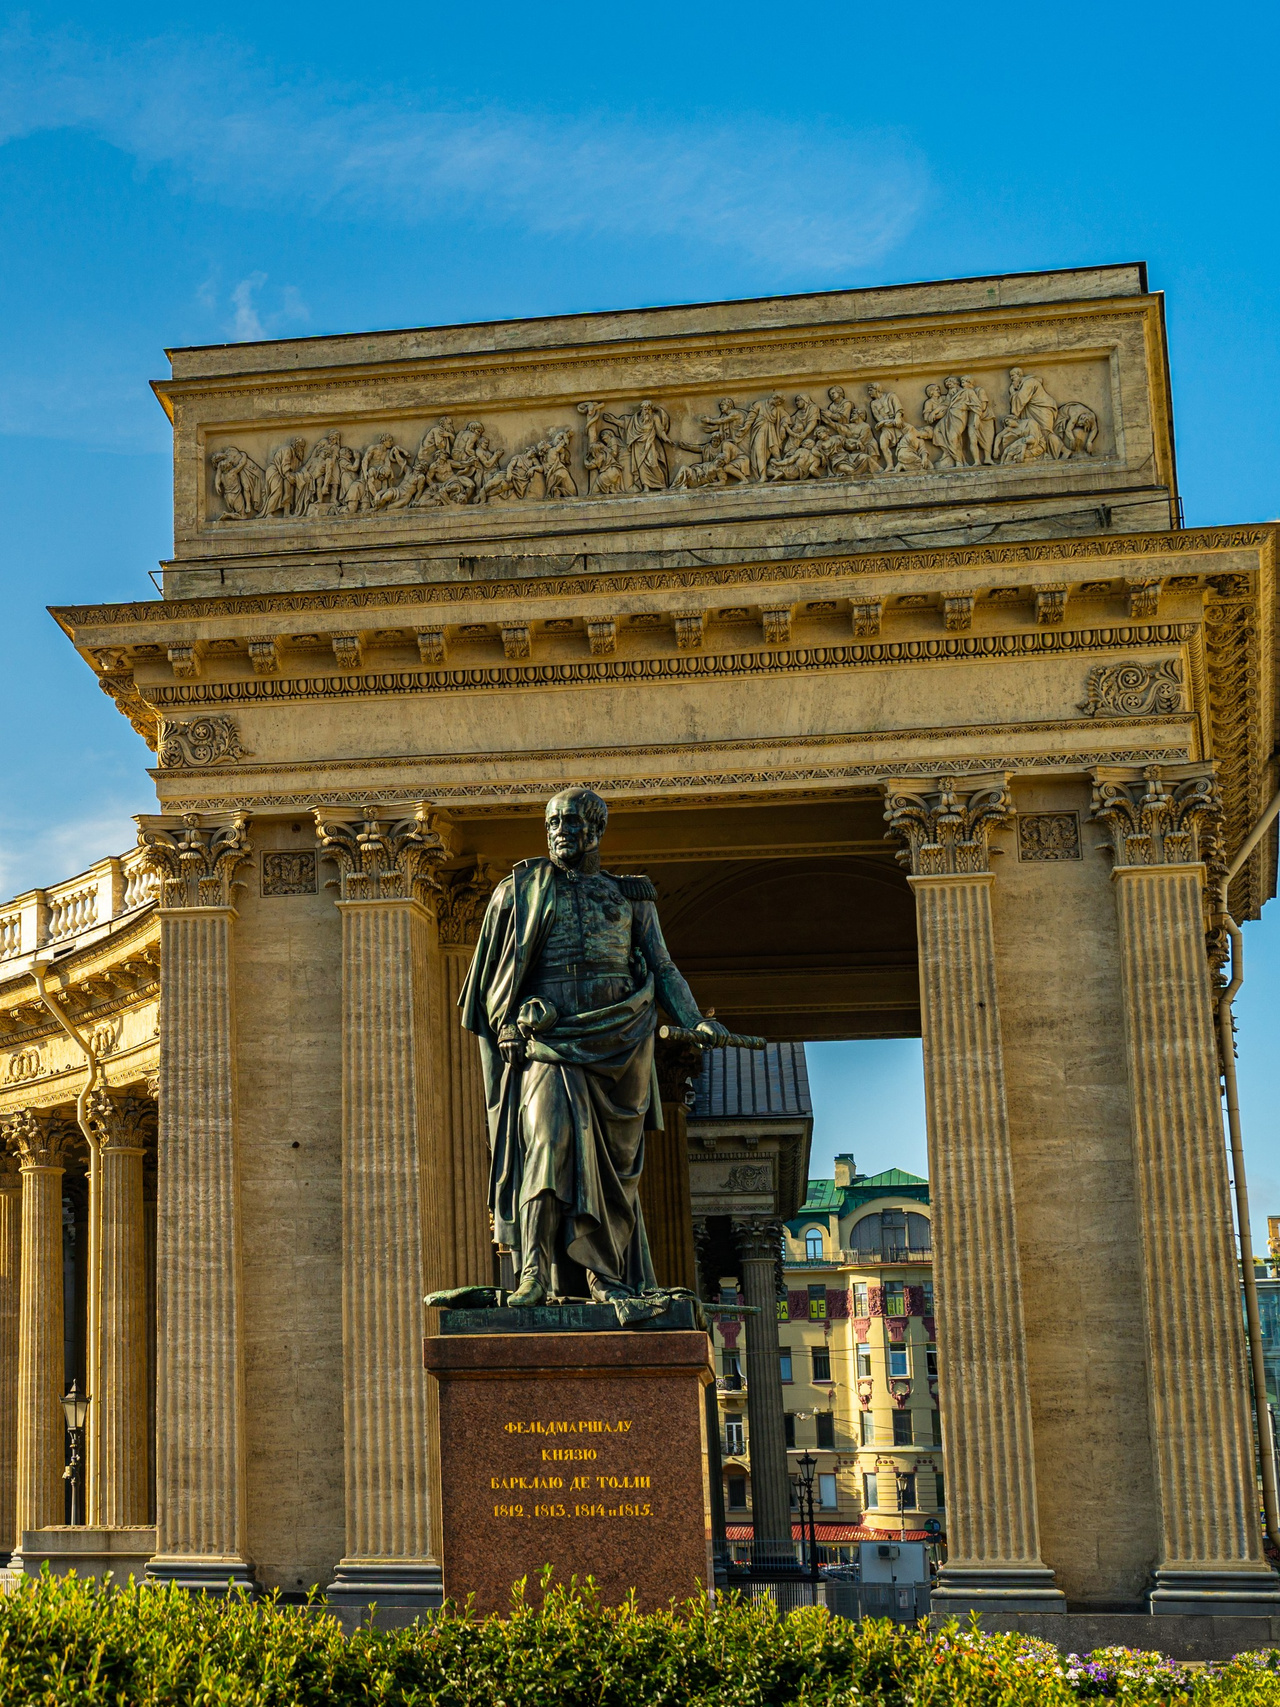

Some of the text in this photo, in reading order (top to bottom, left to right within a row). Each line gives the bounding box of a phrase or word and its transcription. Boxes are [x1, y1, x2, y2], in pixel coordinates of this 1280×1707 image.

[504, 1420, 633, 1436] ФЕЛЬДМАРШАЛУ
[541, 1448, 598, 1461] КНЯЗЮ
[490, 1475, 651, 1491] БАРКЛАЮ ДЕ ТОЛЛИ
[534, 1503, 571, 1518] 1813,
